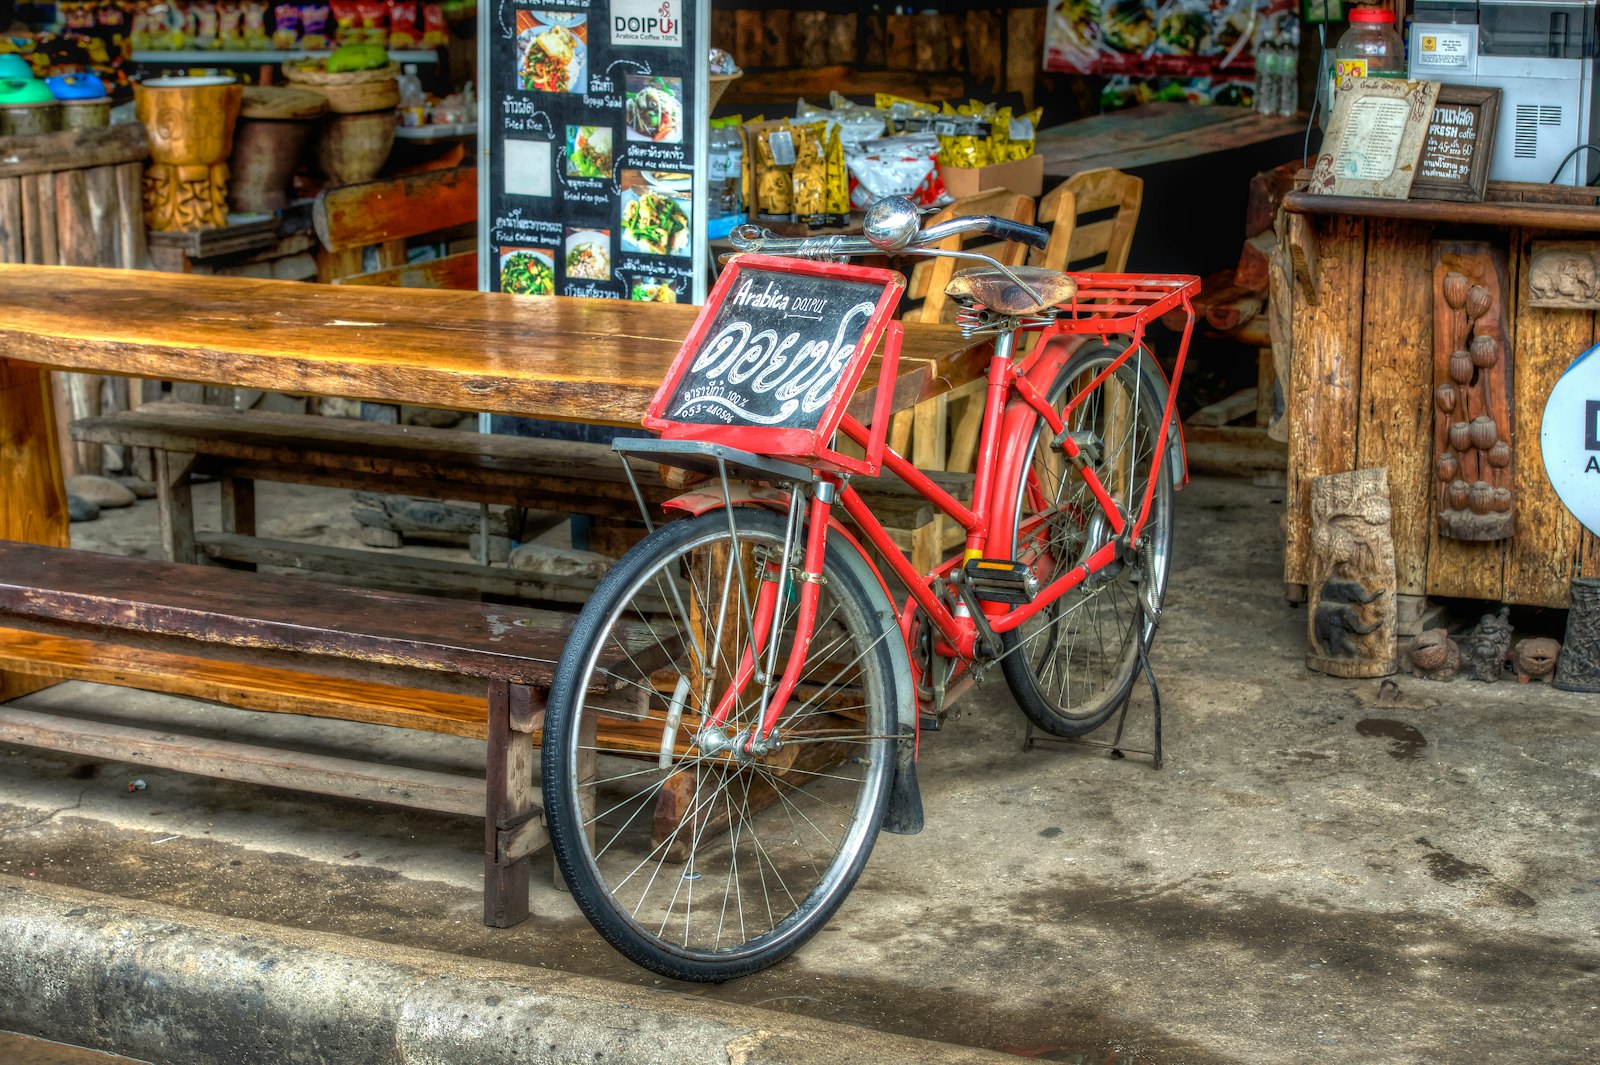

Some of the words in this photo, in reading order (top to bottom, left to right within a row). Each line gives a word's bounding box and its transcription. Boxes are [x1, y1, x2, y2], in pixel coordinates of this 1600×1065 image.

[615, 16, 678, 35] DOIPUI
[504, 118, 524, 130] Fried
[526, 119, 543, 131] Rice
[1430, 106, 1474, 126] กาแฟสด
[1429, 124, 1458, 138] FRESH
[1458, 128, 1476, 139] coffee
[733, 278, 790, 310] Arabica
[791, 296, 828, 314] DOIPUI
[691, 301, 876, 422] ดอยปุย
